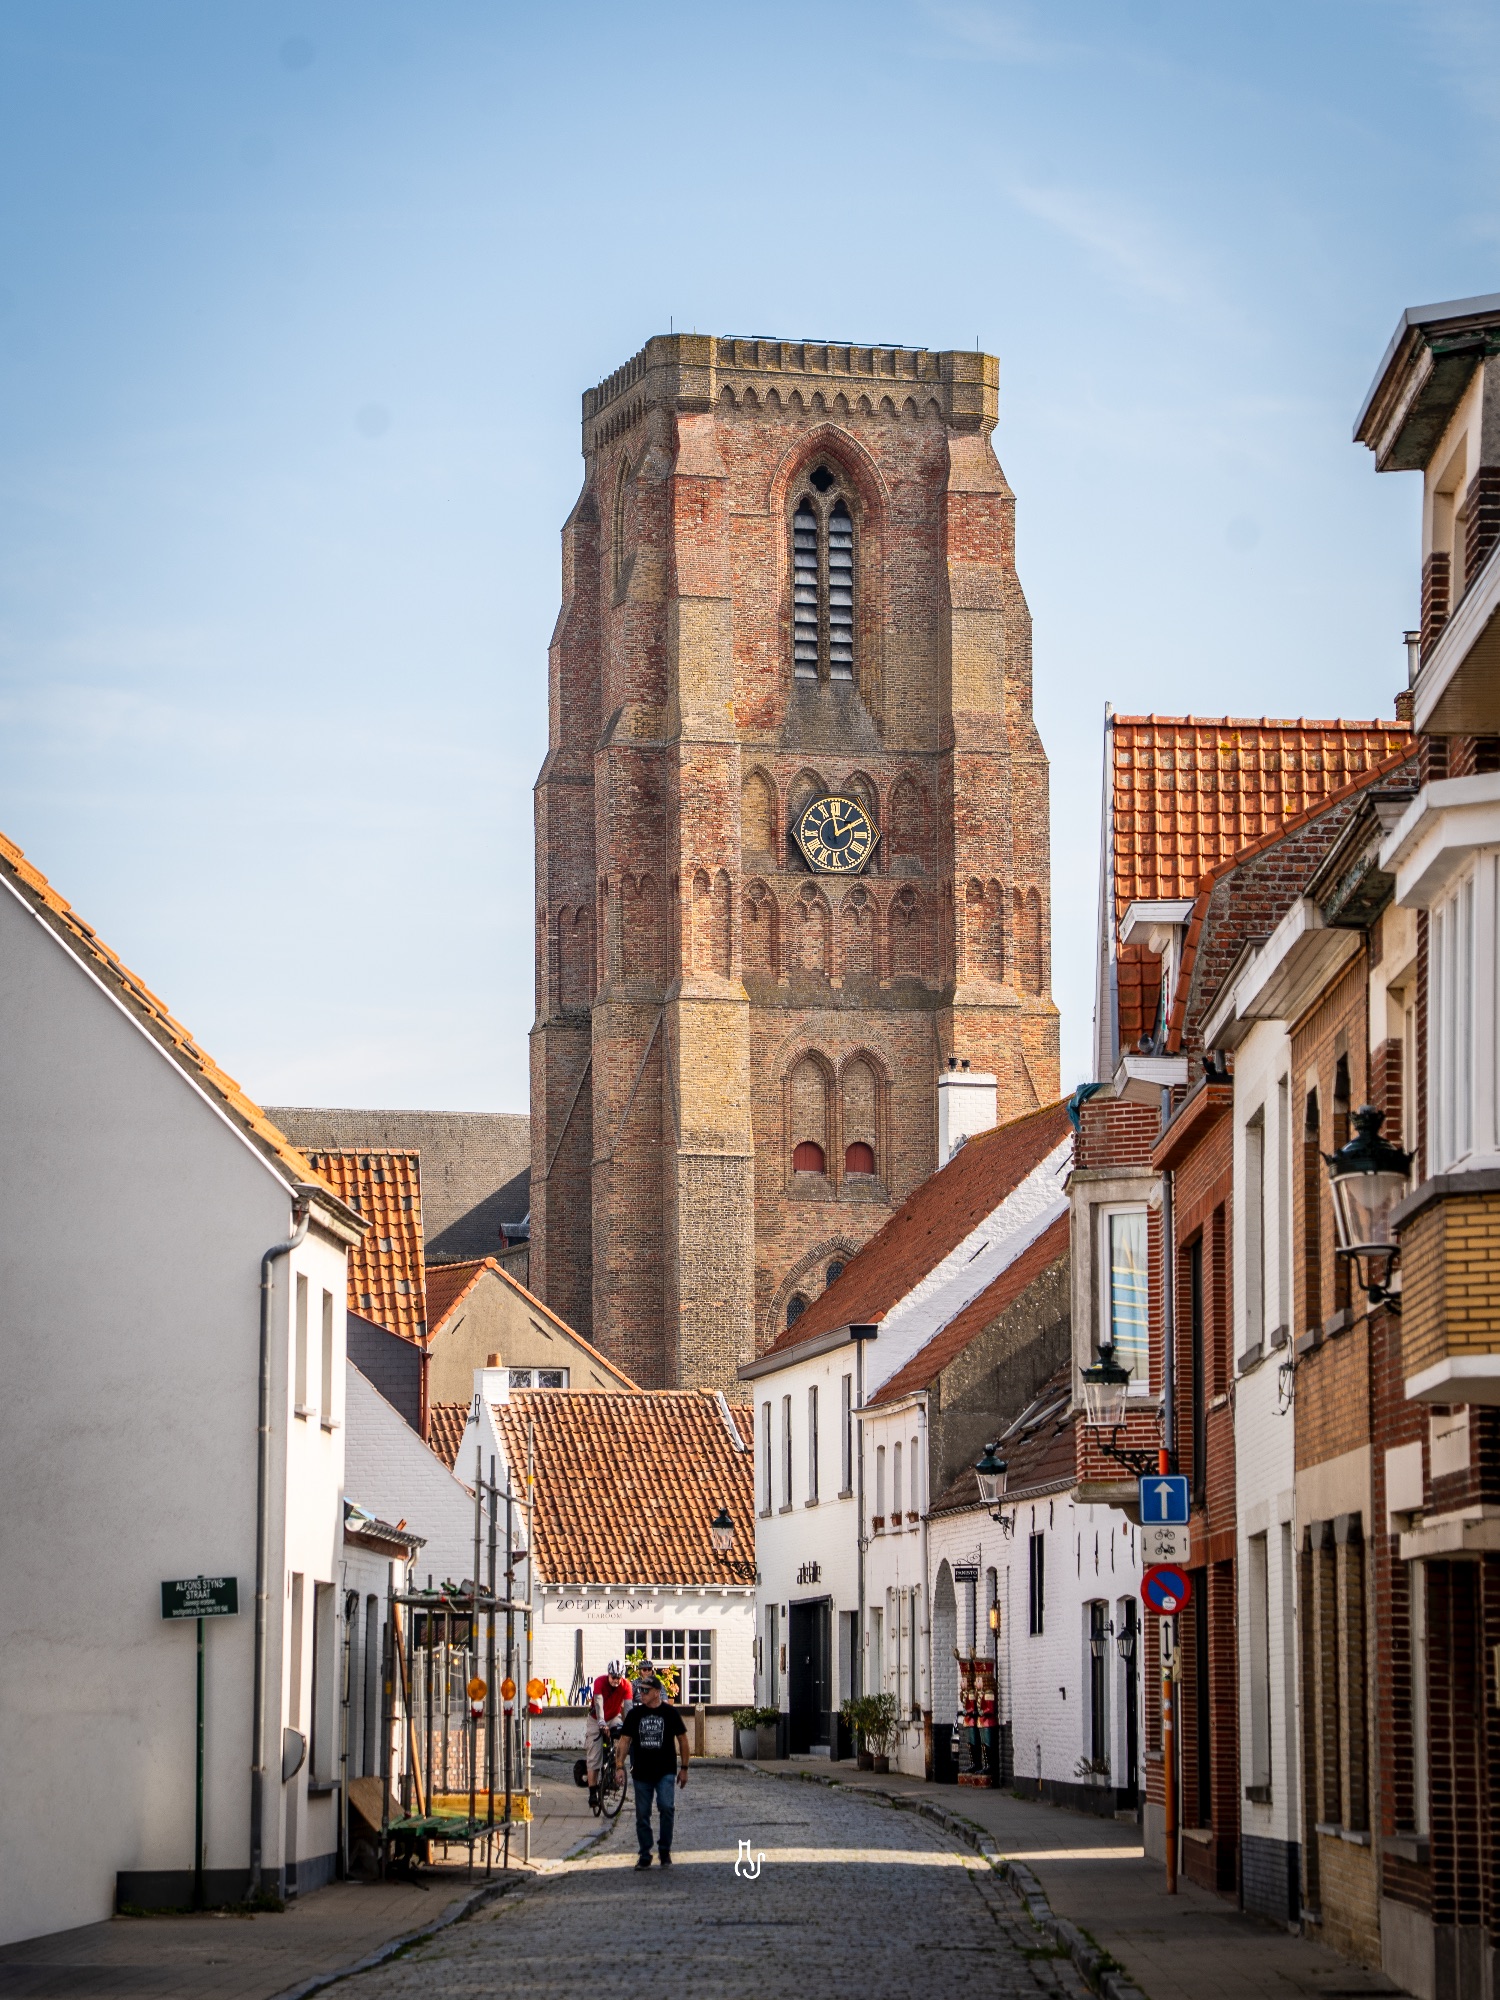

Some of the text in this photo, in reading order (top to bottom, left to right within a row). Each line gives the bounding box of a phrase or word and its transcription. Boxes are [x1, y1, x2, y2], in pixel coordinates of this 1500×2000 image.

[175, 1578, 226, 1592] ALFONS STYNS-
[185, 1589, 210, 1600] STRAAT
[556, 1599, 653, 1610] ZOETE KUNST
